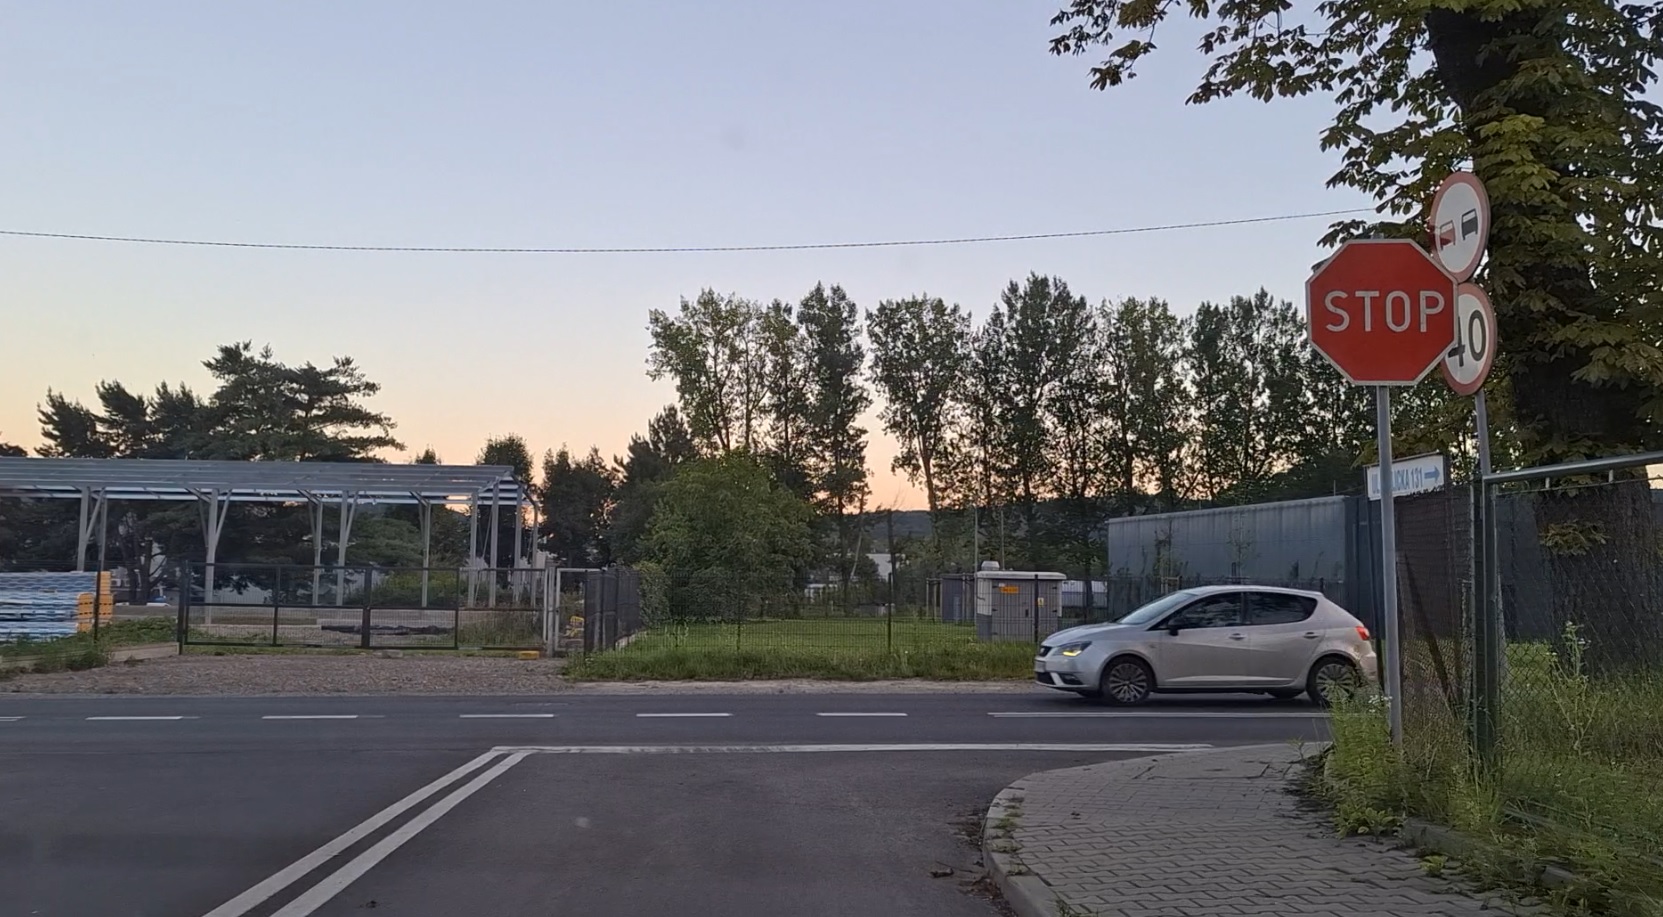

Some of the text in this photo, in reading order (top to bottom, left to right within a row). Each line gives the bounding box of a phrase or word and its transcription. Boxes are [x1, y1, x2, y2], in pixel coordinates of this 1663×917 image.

[1324, 290, 1445, 333] STOP
[1447, 309, 1486, 367] 40
[1411, 466, 1423, 489] 131
